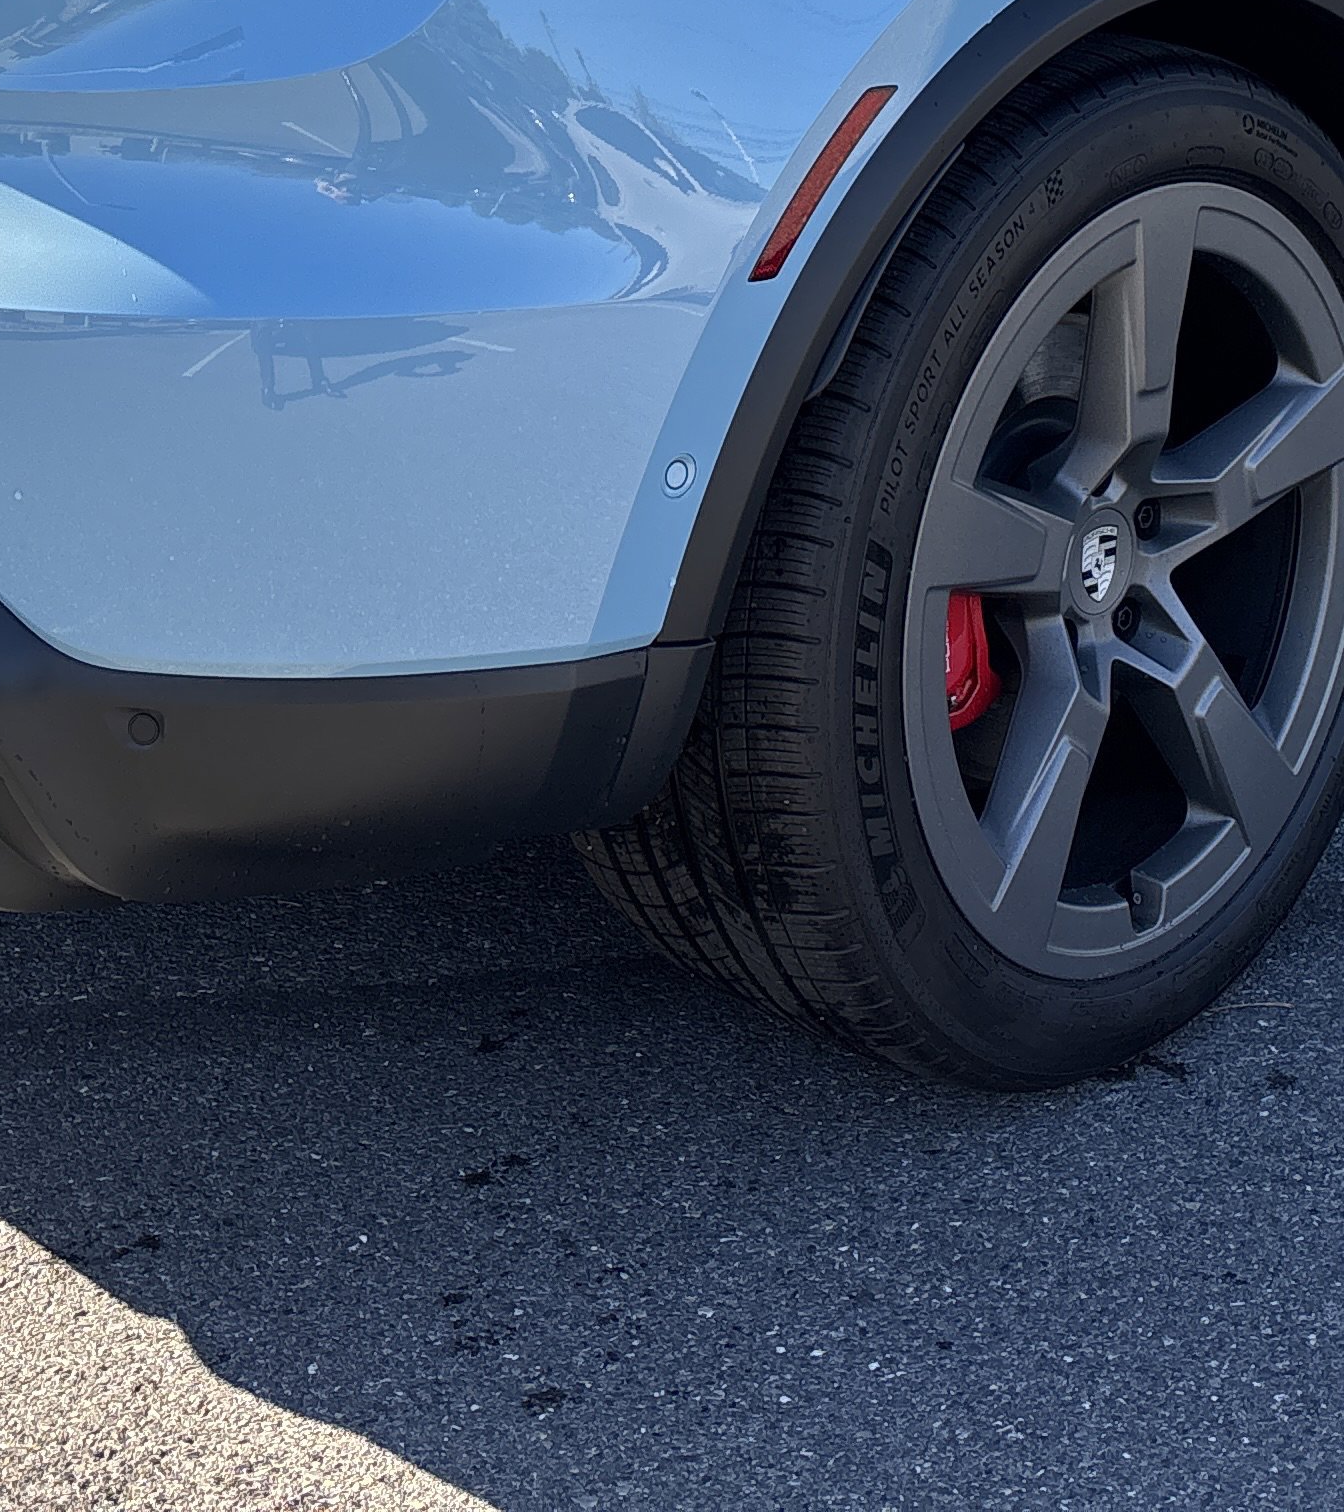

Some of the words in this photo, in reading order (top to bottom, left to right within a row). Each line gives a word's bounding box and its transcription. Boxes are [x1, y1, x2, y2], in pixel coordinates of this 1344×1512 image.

[879, 439, 909, 517] PILOT
[905, 352, 943, 435] SPORT
[944, 303, 969, 352] ALL
[969, 215, 1026, 299] SEASON
[856, 558, 895, 858] MICHELIN
